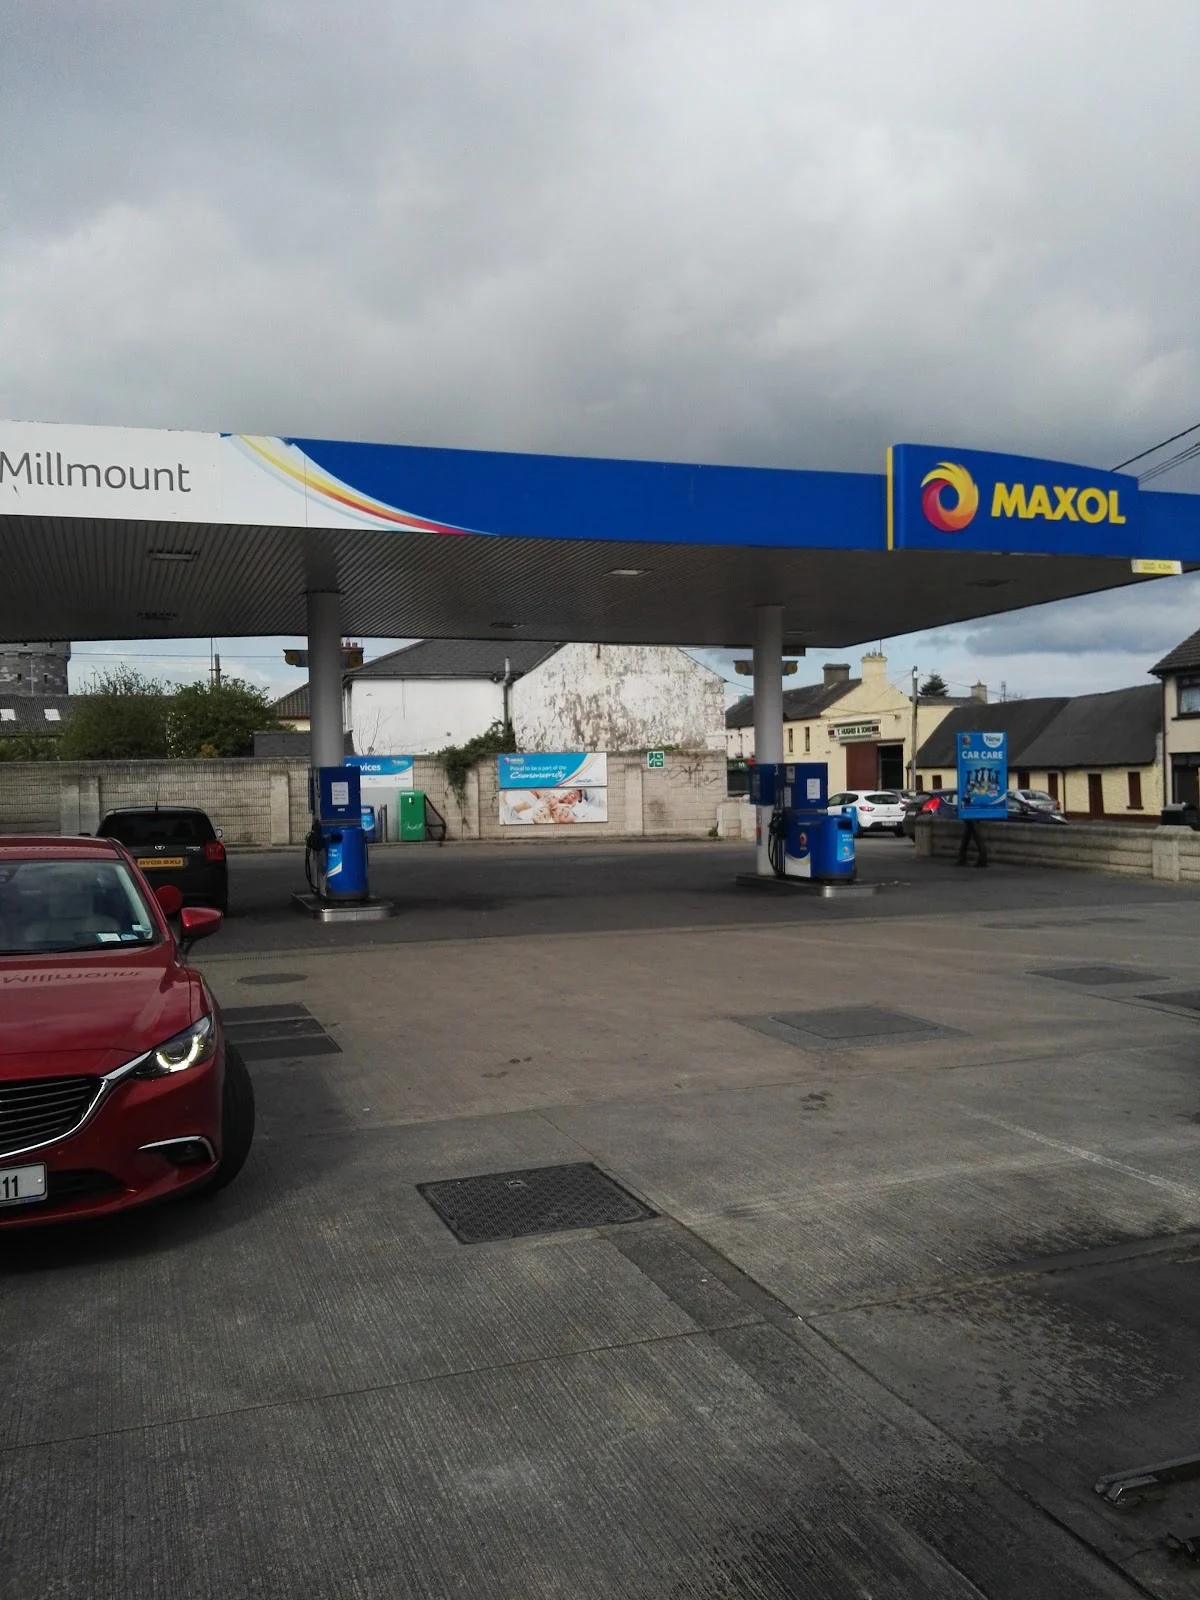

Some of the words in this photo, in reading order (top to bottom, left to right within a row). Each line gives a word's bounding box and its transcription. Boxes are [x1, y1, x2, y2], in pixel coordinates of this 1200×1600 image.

[0, 451, 191, 492] Millmount
[991, 482, 1126, 524] MAXOL
[962, 751, 979, 759] CAR
[981, 751, 1003, 759] CARE
[510, 771, 566, 781] Community
